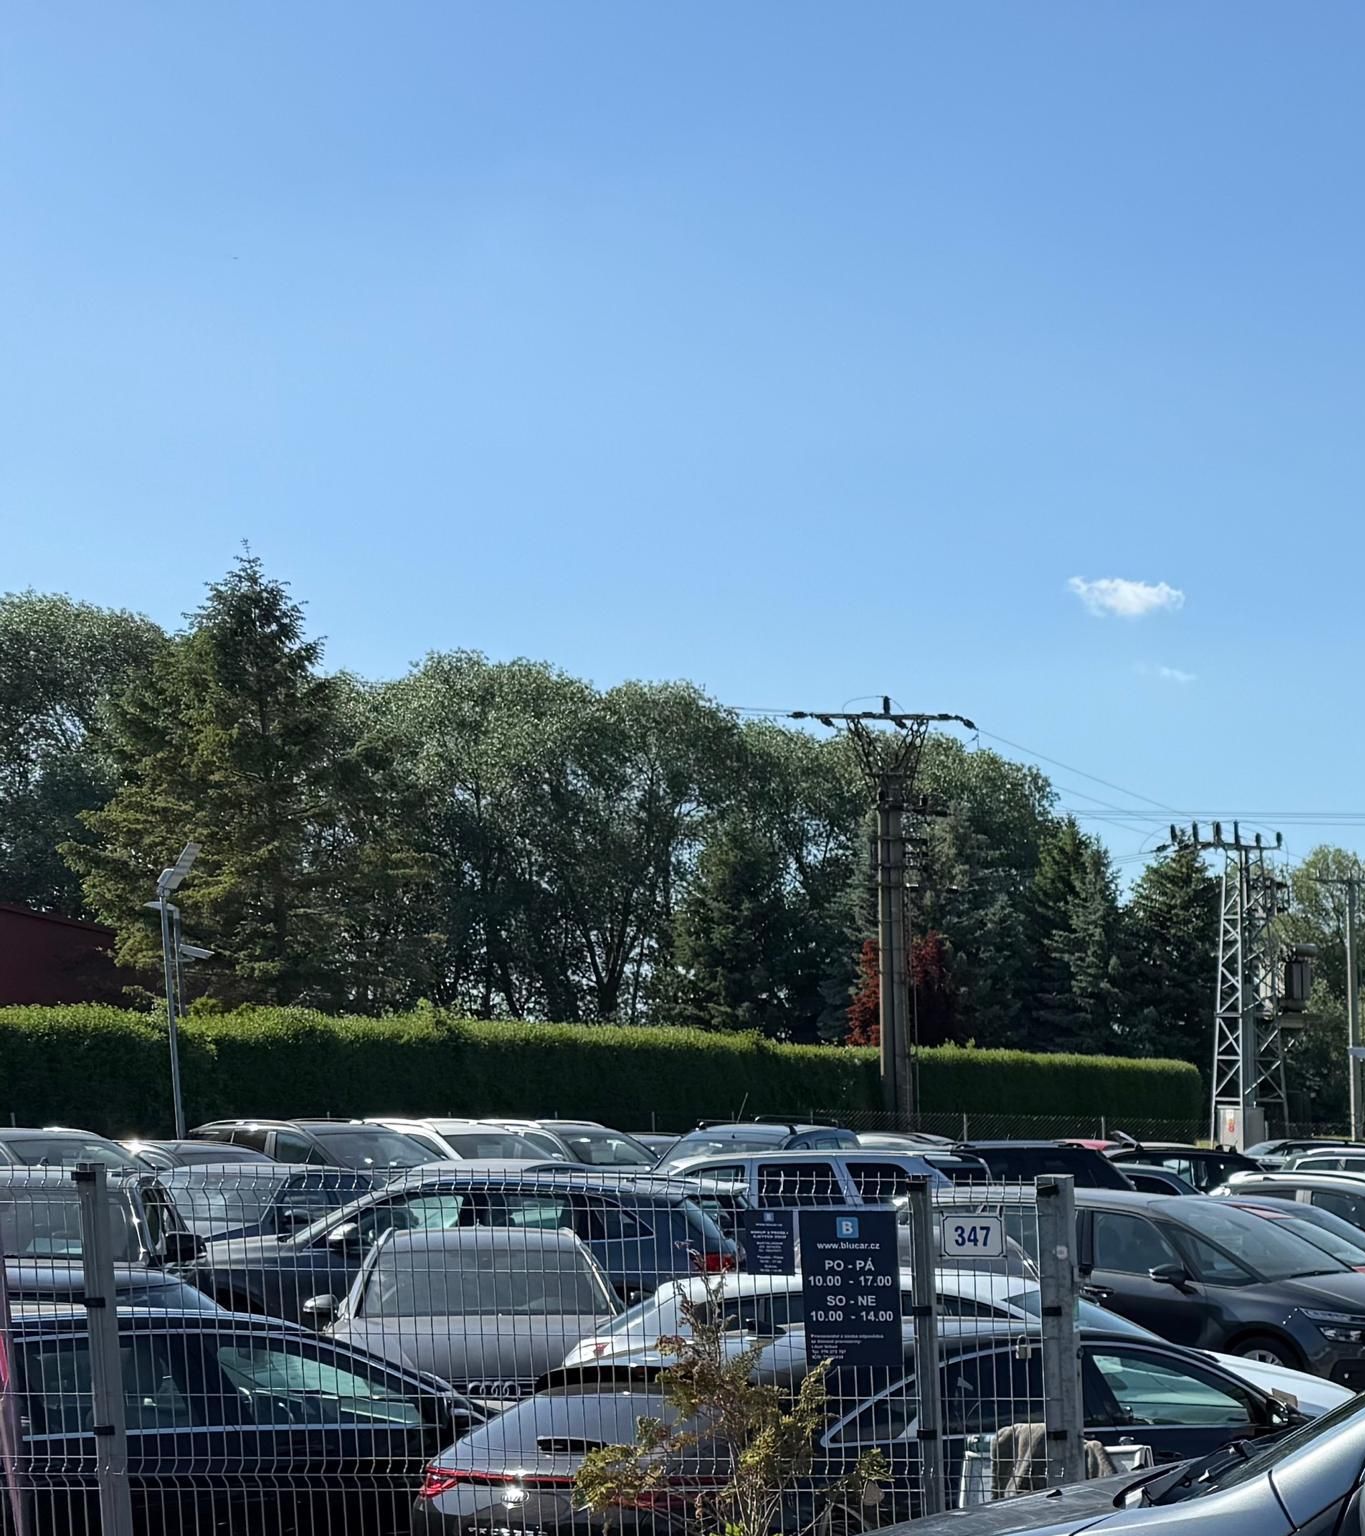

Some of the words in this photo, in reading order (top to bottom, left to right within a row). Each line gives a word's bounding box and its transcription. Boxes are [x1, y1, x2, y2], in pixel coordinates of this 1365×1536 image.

[841, 1221, 853, 1235] B
[954, 1226, 991, 1247] 347
[816, 1241, 880, 1250] www.blucar.cz
[824, 1260, 845, 1271] PO
[856, 1257, 875, 1271] PÁ
[809, 1275, 842, 1286] 10.00
[859, 1275, 892, 1286] 17.00
[826, 1295, 846, 1306] SO
[858, 1295, 877, 1306] NE
[810, 1310, 843, 1321] 10.00
[860, 1310, 893, 1321] 14.00
